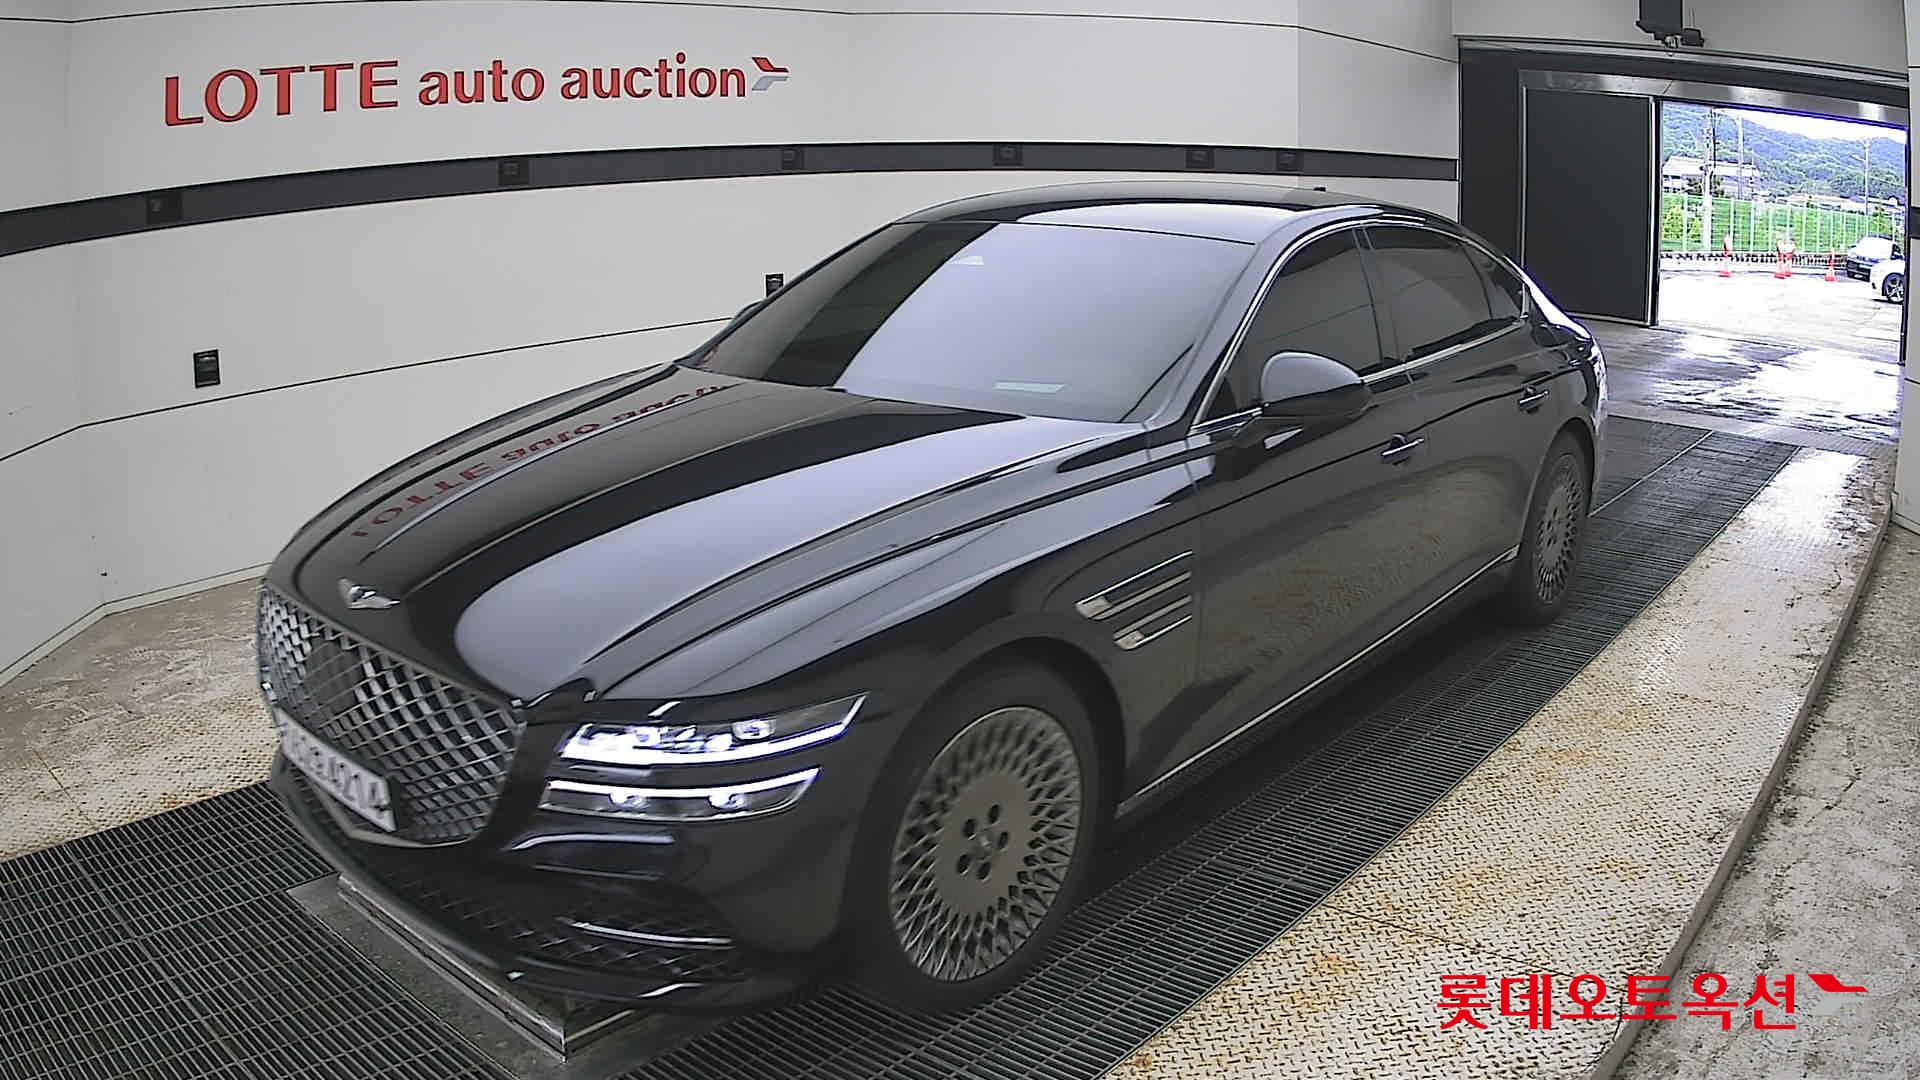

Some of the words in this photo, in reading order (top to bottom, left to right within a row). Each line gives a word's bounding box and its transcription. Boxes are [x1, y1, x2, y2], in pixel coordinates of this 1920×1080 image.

[164, 60, 399, 126] LOTTE
[418, 59, 545, 106] auto
[560, 52, 746, 100] auction
